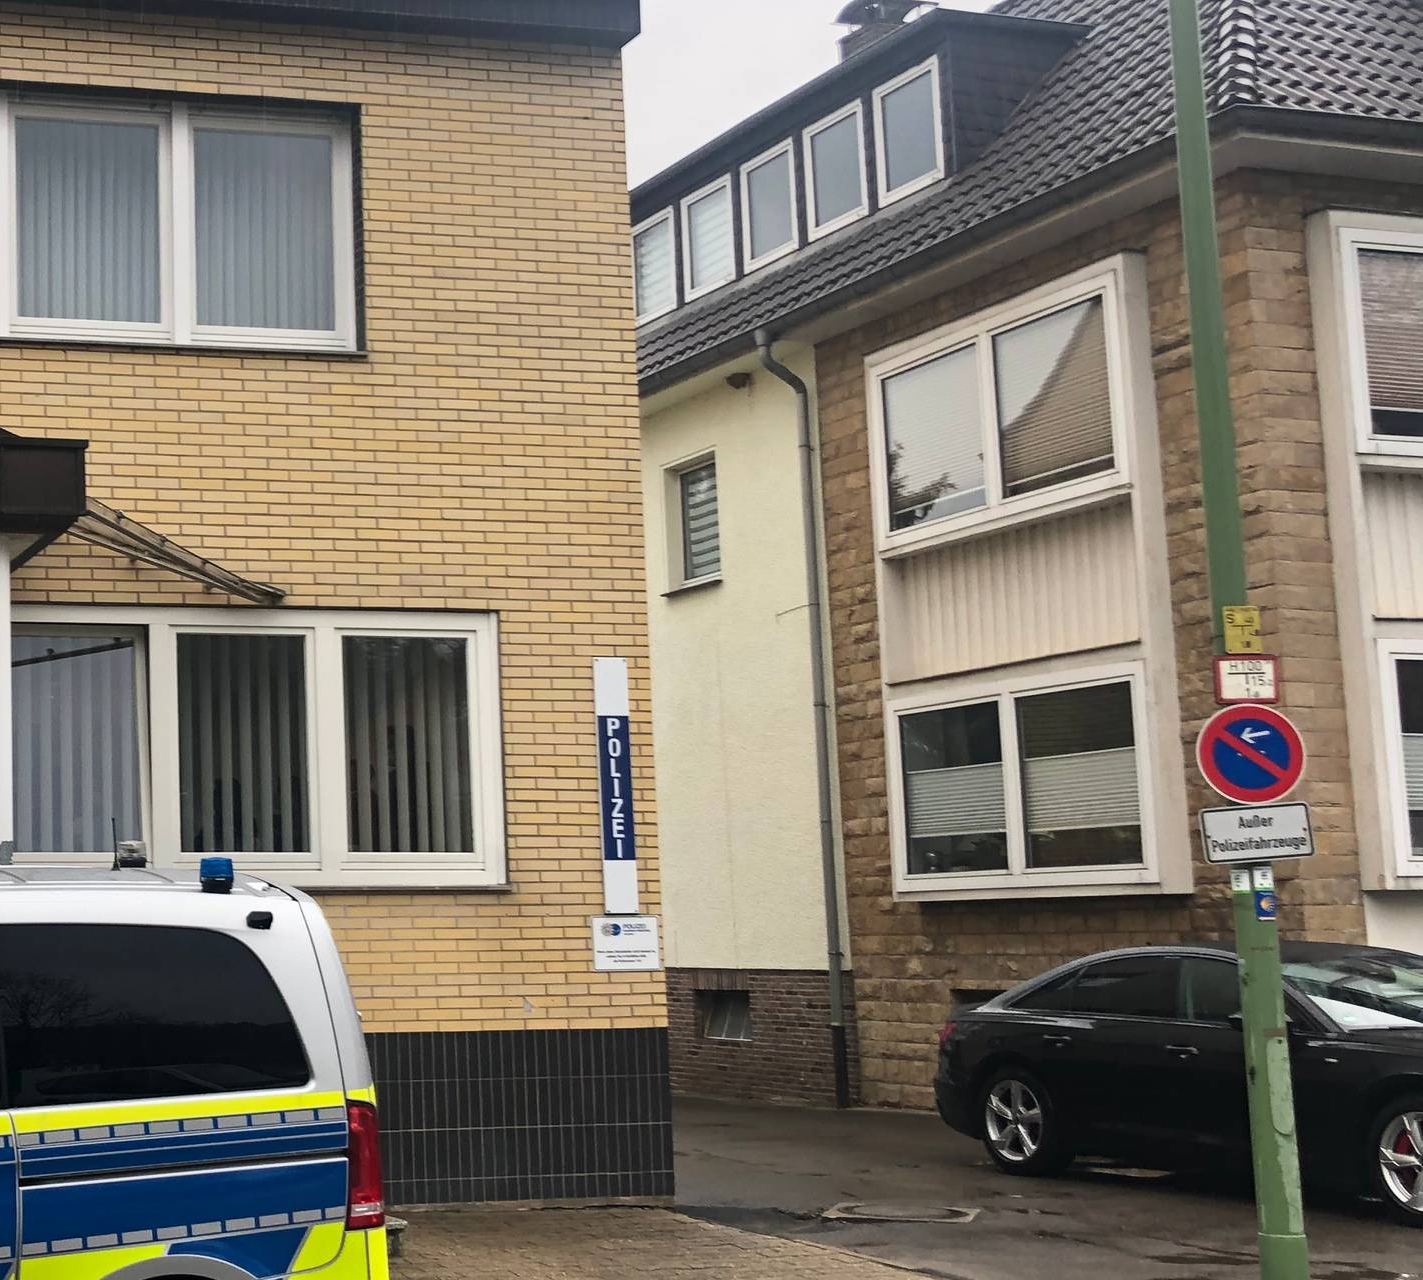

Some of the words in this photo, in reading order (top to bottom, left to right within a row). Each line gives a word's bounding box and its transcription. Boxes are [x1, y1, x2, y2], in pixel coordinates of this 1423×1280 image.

[606, 717, 626, 859] POLIZEI
[1238, 814, 1274, 829] Außer
[1212, 835, 1307, 853] Polizeifahrzeuge
